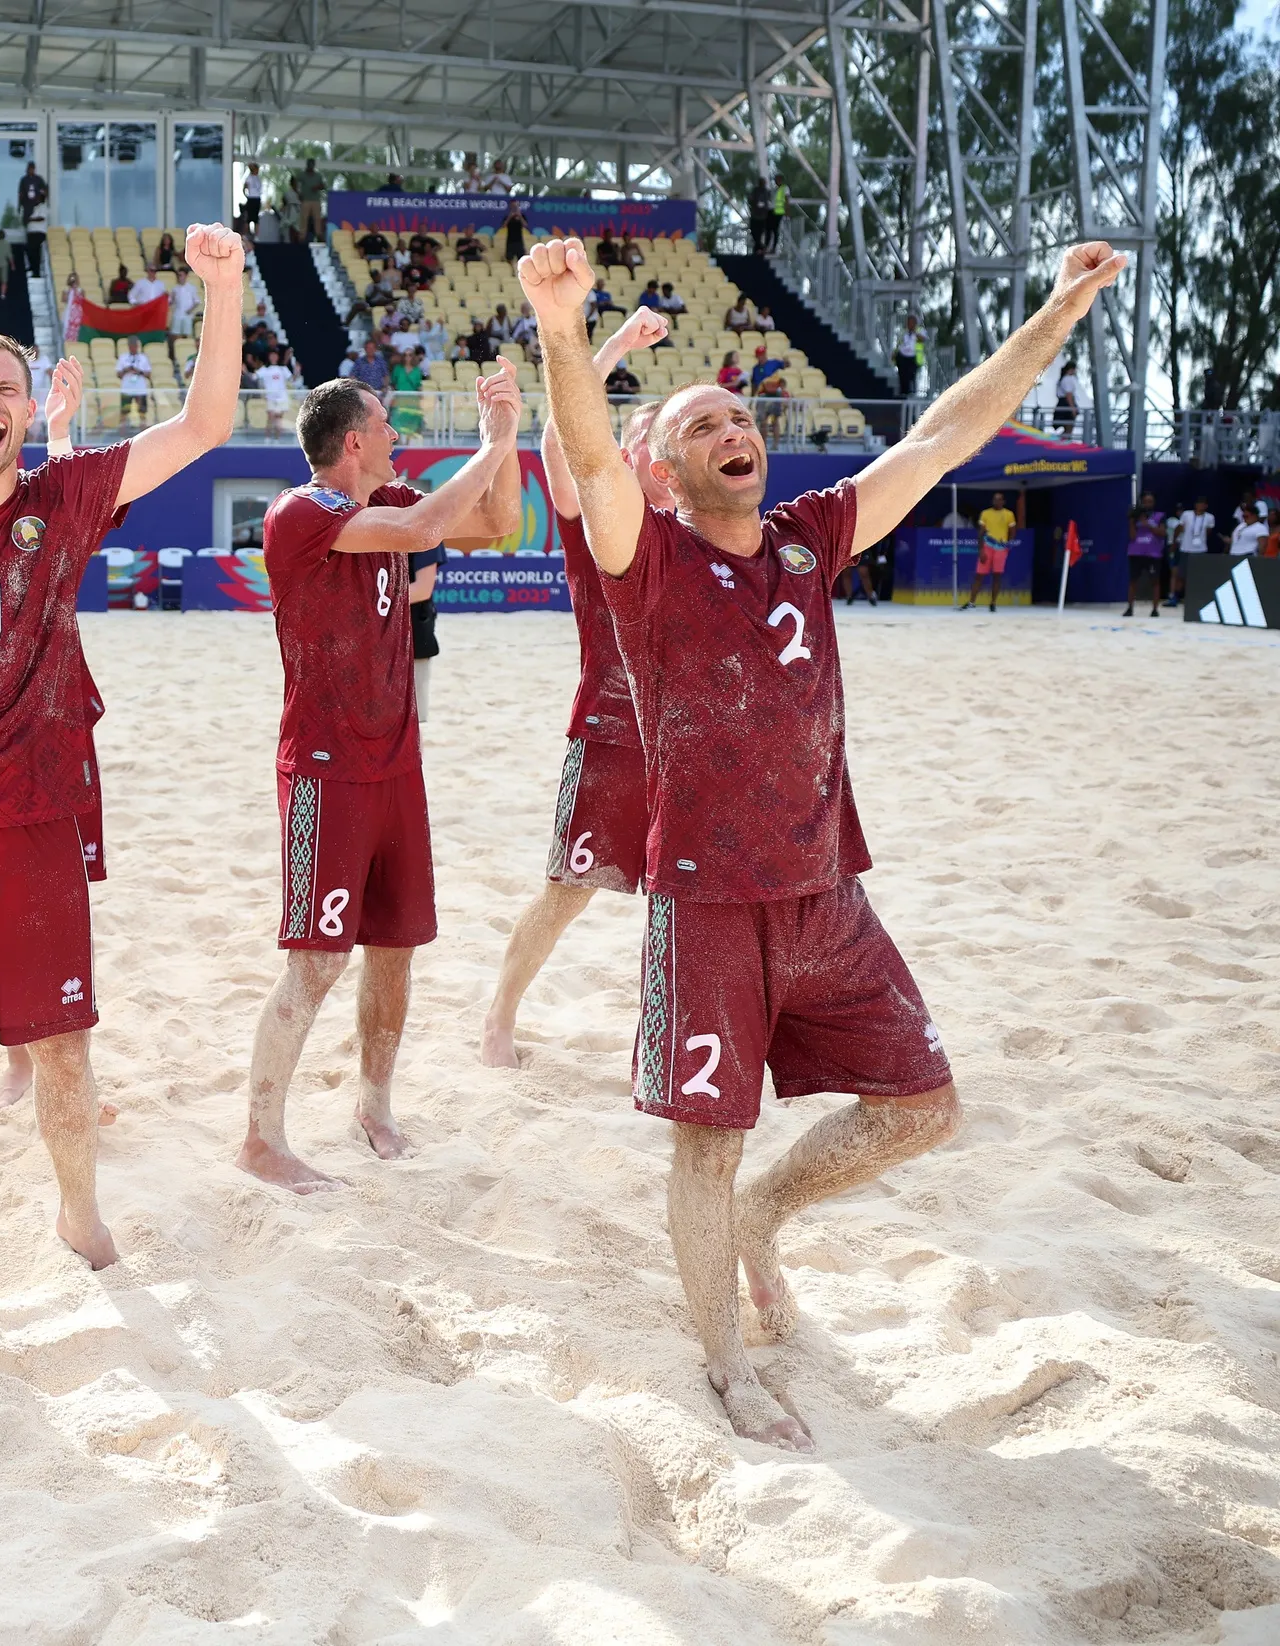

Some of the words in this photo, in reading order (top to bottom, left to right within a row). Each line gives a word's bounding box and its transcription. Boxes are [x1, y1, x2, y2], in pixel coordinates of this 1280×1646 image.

[366, 197, 390, 208] FIFA
[392, 198, 426, 208] BEACH
[428, 199, 468, 209] SOCCER
[470, 200, 508, 211] WORLD
[377, 567, 392, 616] 8
[446, 570, 500, 585] SOCCER
[501, 570, 554, 585] WORLD
[767, 601, 811, 666] 2
[570, 831, 594, 873] 6
[319, 888, 350, 937] 8
[681, 1033, 721, 1099] 2
